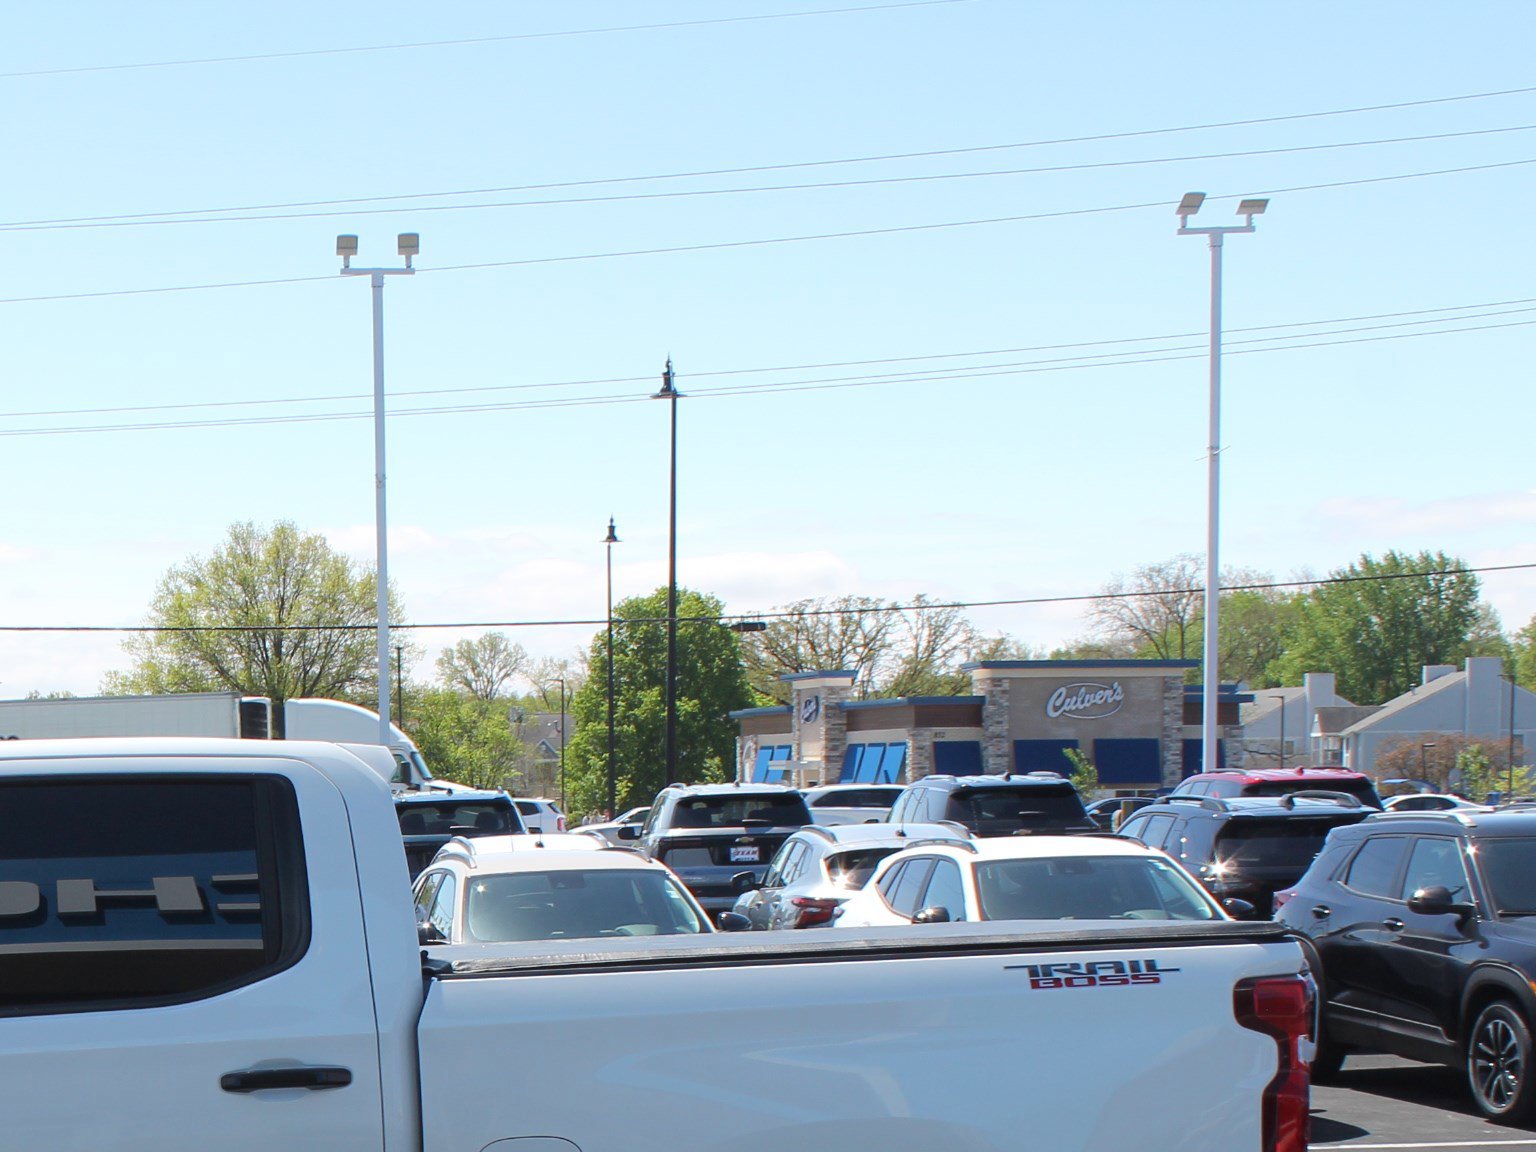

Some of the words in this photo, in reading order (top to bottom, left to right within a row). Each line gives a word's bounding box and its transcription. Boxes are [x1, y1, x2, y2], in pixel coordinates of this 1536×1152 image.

[1046, 682, 1125, 718] Culver's
[1004, 959, 1180, 977] TRAIL
[1029, 973, 1161, 990] BOSS
